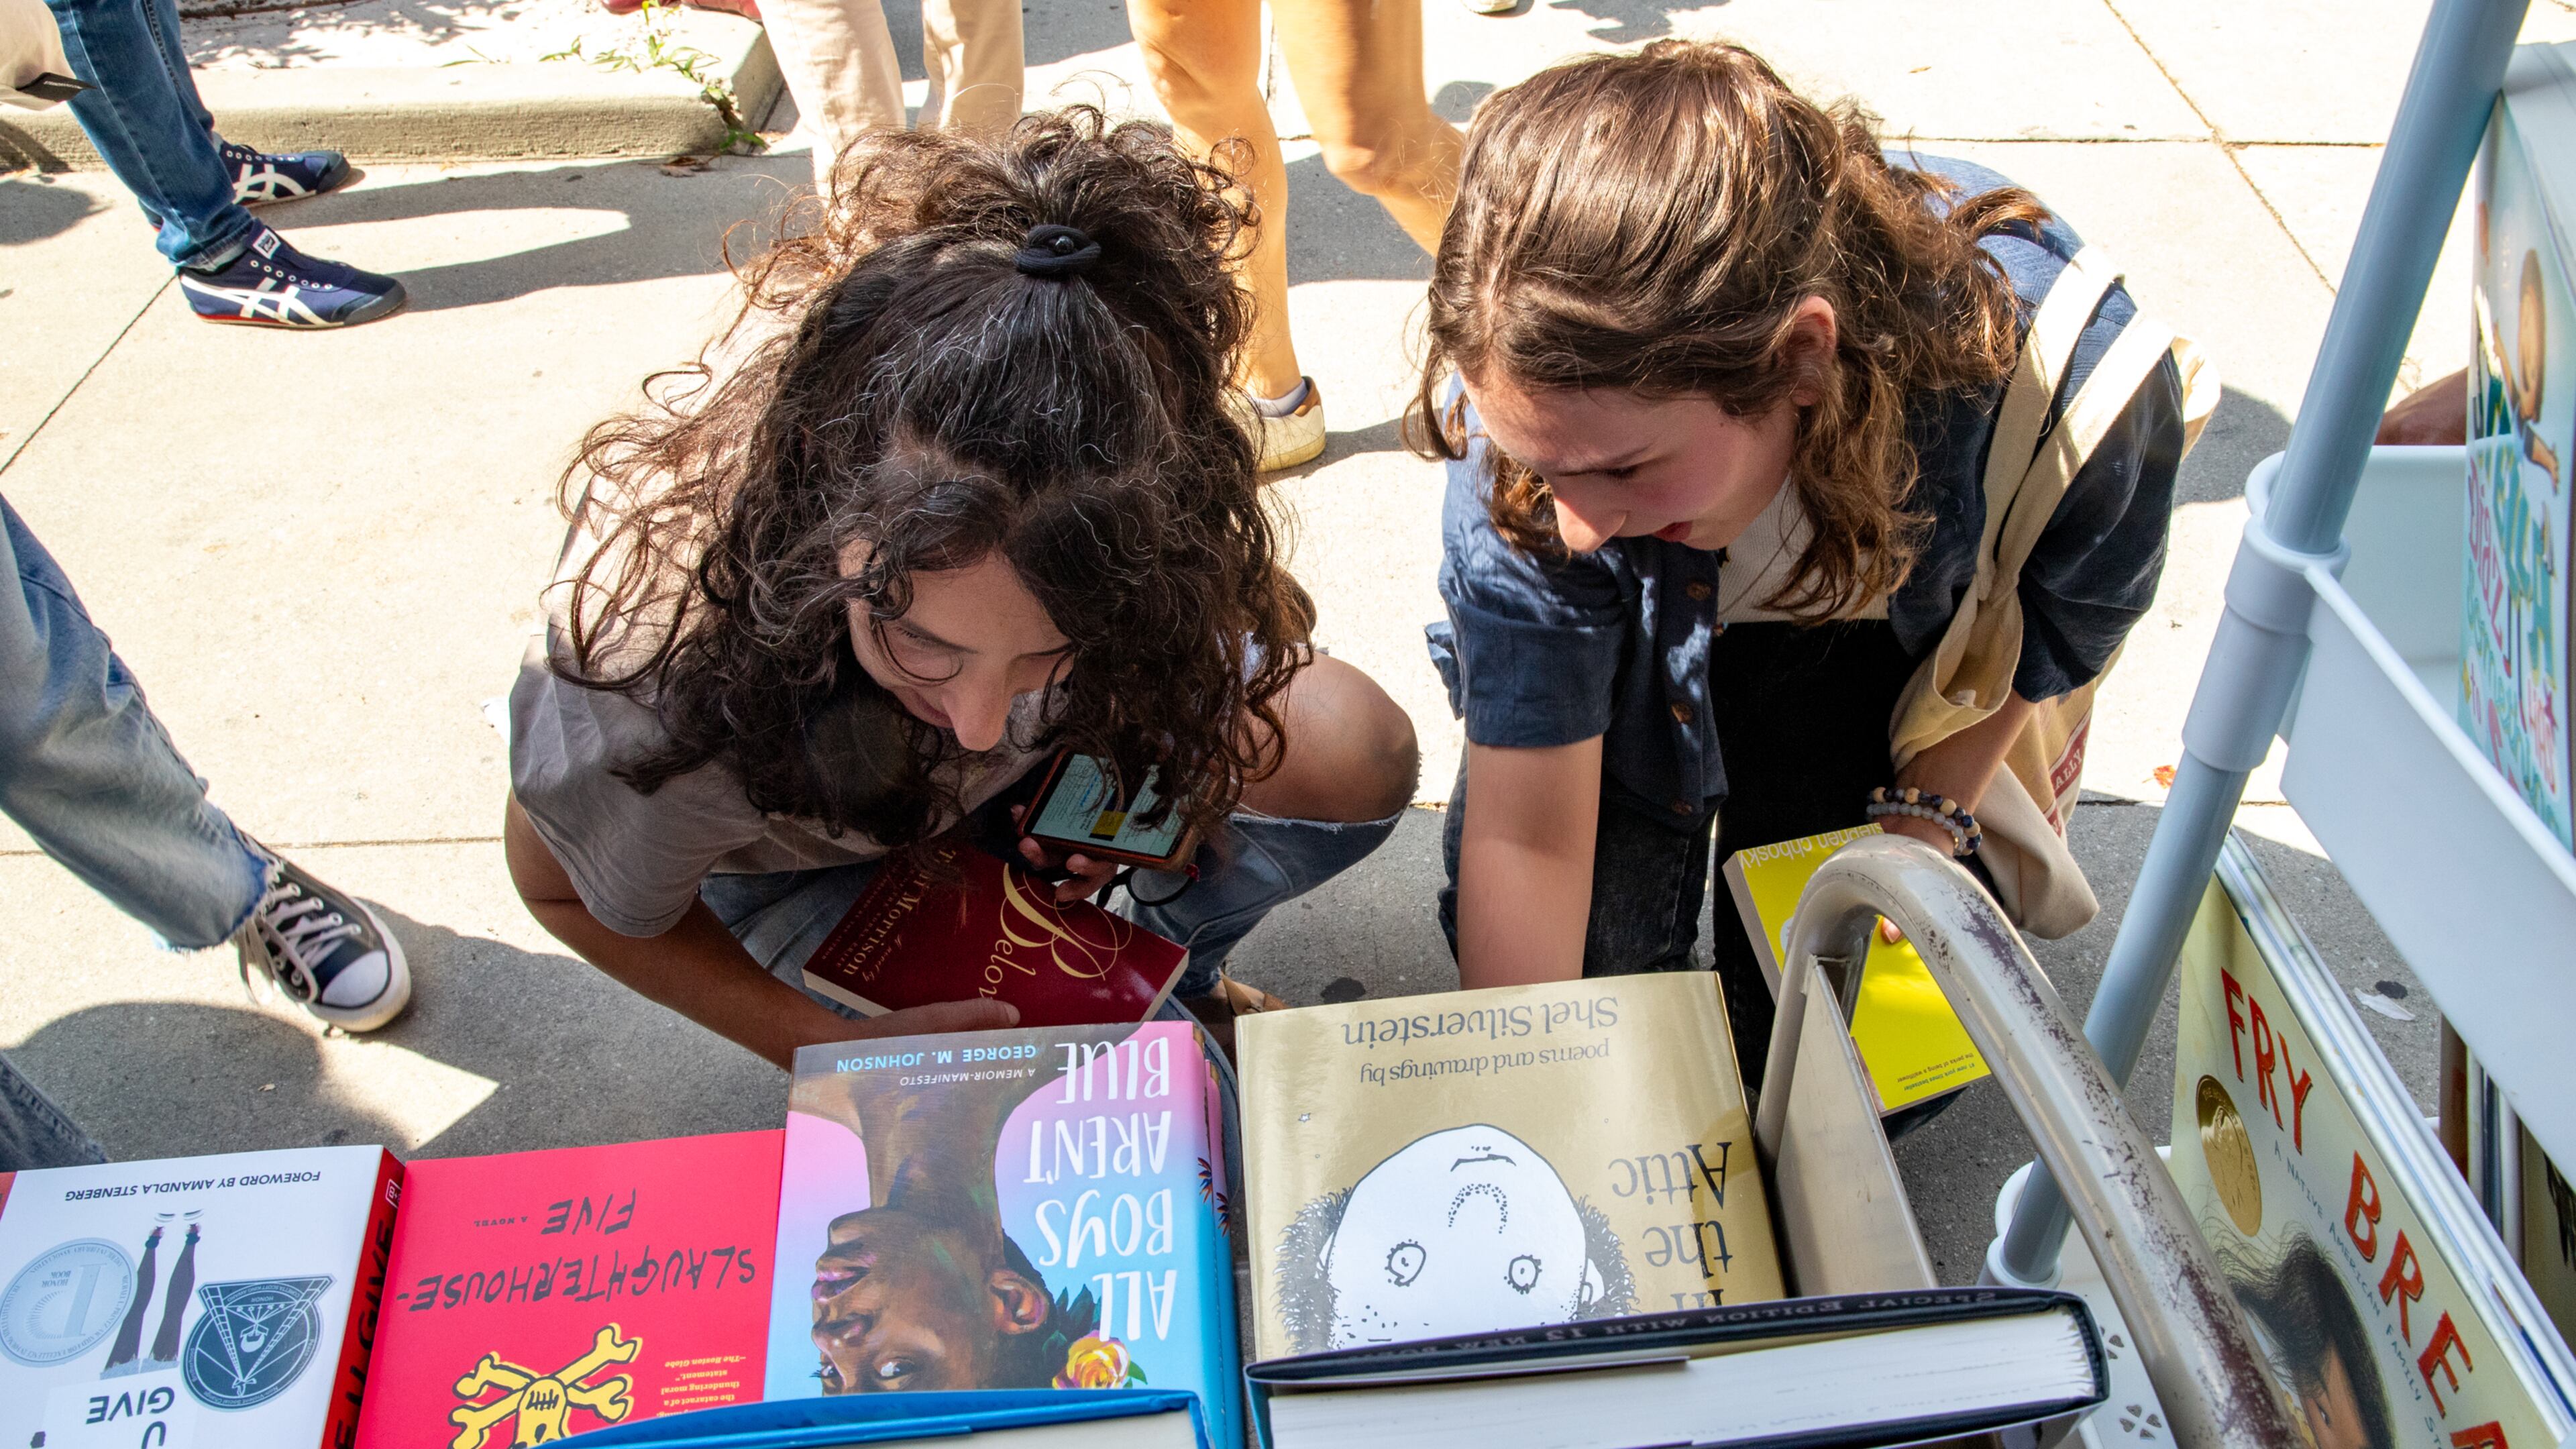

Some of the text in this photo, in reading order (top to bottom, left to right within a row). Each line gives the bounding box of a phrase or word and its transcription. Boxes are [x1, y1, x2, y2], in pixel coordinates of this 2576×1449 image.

[1739, 837, 1813, 870] chbosky
[843, 848, 957, 975] Tni Morrison
[978, 862, 1134, 1000] Belov
[1341, 996, 1619, 1050] Shel Silverstein
[836, 1044, 1036, 1073] GEORGE M. JOHNSON
[1054, 1036, 1171, 1105] BLUE
[1359, 1037, 1611, 1087] poems and drawings by
[2220, 966, 2314, 1155] FRY
[899, 1068, 1036, 1087] A MEMOIR-MANIFESTO
[1022, 1110, 1172, 1187] AREN'T
[64, 1171, 321, 1201] FOREWORD BY AMANDLA STENBERG
[1608, 1141, 1733, 1209] Attic
[474, 1216, 529, 1228] A NOVEL
[541, 1187, 637, 1236] FIVE
[1034, 1188, 1173, 1269] BOYS
[1642, 1220, 1733, 1280] the
[42, 1279, 69, 1289] HONOR
[51, 1271, 71, 1279] BOOK
[250, 1295, 274, 1303] HONOR
[1091, 1269, 1178, 1342] ALL
[2273, 1138, 2443, 1449] A NATIVE AMERICAN FAMILY ST
[664, 1360, 690, 1368] Globe
[692, 1356, 722, 1366] Boston
[661, 1381, 740, 1395] thundering moral
[670, 1399, 680, 1407] of
[681, 1395, 719, 1405] cataract
[720, 1394, 735, 1402] the
[86, 1386, 175, 1425] GIVE
[141, 1420, 167, 1449] U
